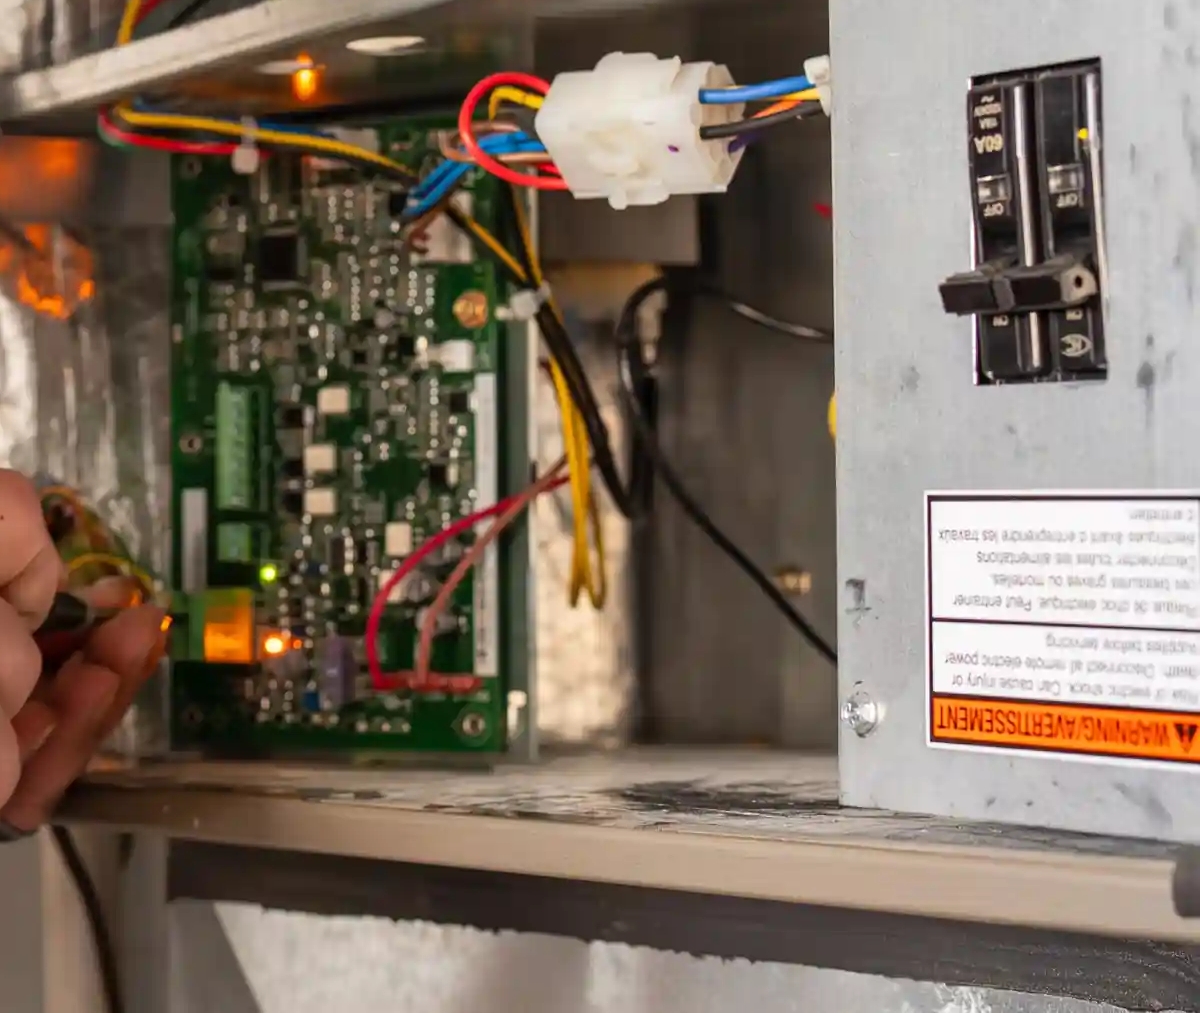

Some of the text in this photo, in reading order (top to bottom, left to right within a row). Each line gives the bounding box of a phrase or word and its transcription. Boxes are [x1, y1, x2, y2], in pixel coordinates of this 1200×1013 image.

[939, 529, 980, 543] travaux
[982, 530, 997, 541] les
[1005, 595, 1032, 611] Peut
[982, 655, 1021, 668] electric
[952, 674, 962, 685] or
[1000, 677, 1033, 690] cause
[1038, 679, 1060, 696] Can
[938, 704, 1170, 746] WARNING/AVERTISSEMENT
